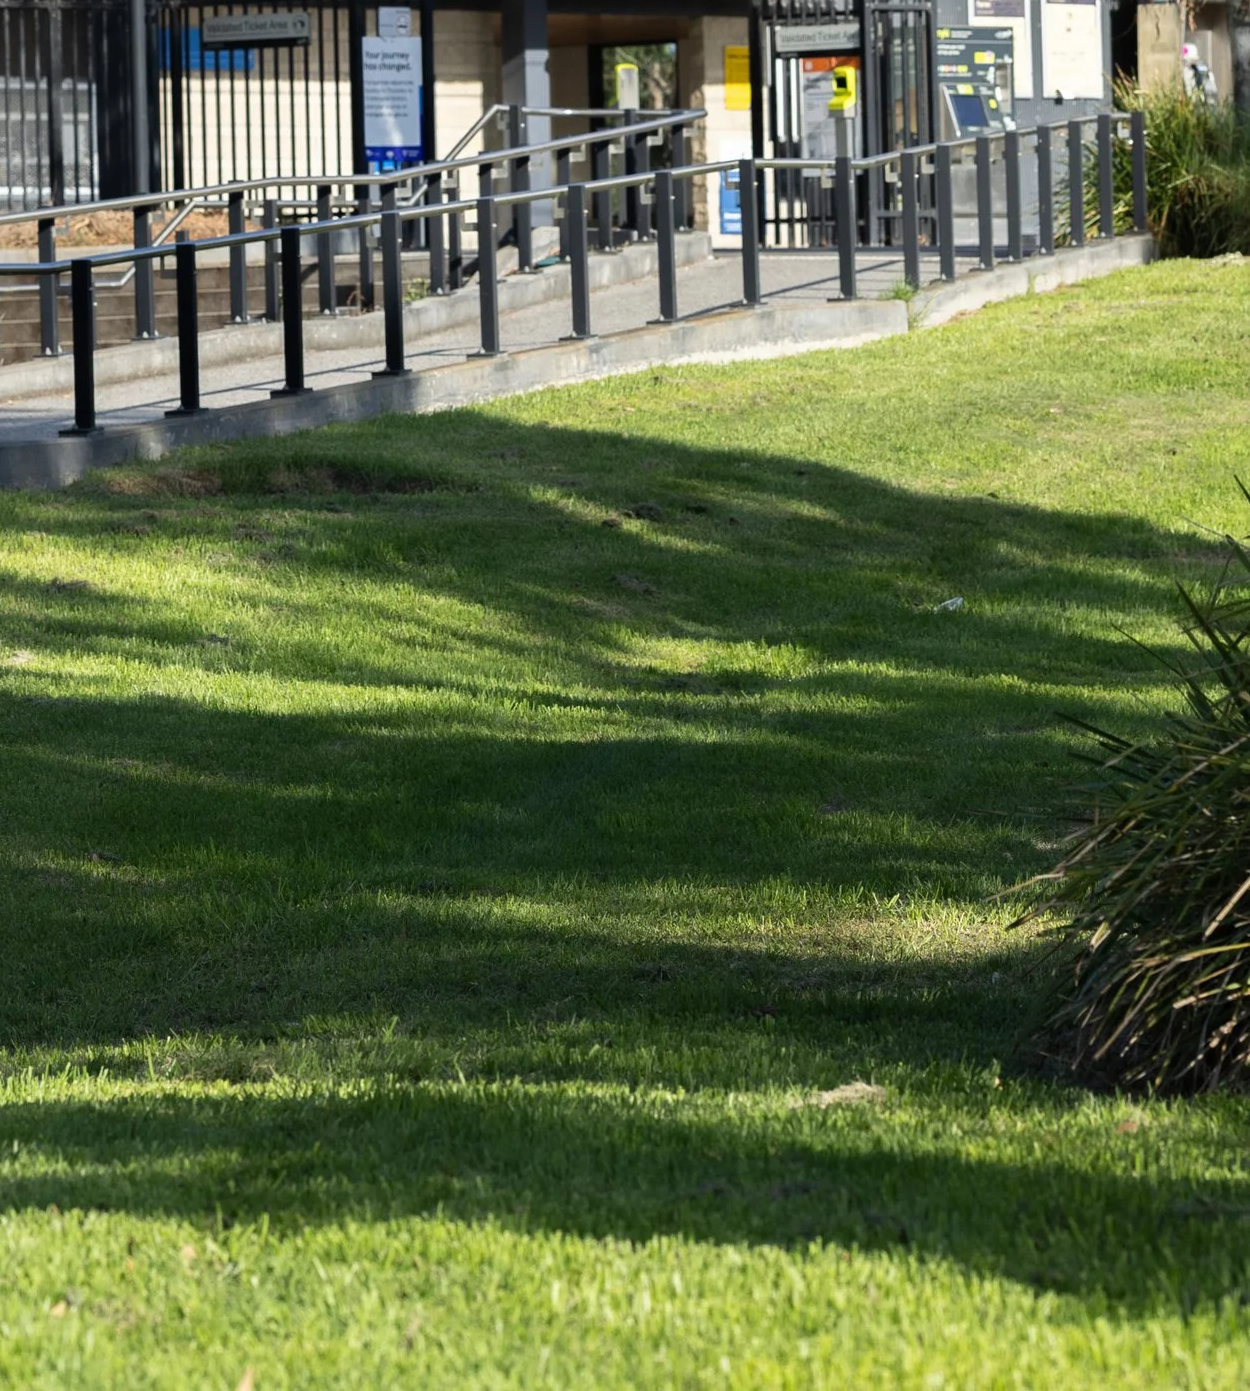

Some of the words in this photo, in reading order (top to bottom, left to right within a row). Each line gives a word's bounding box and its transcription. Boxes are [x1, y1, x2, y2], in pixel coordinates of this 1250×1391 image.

[244, 21, 267, 31] Ticket
[817, 31, 841, 42] Ticket
[365, 51, 380, 59] Your
[381, 50, 410, 62] journey
